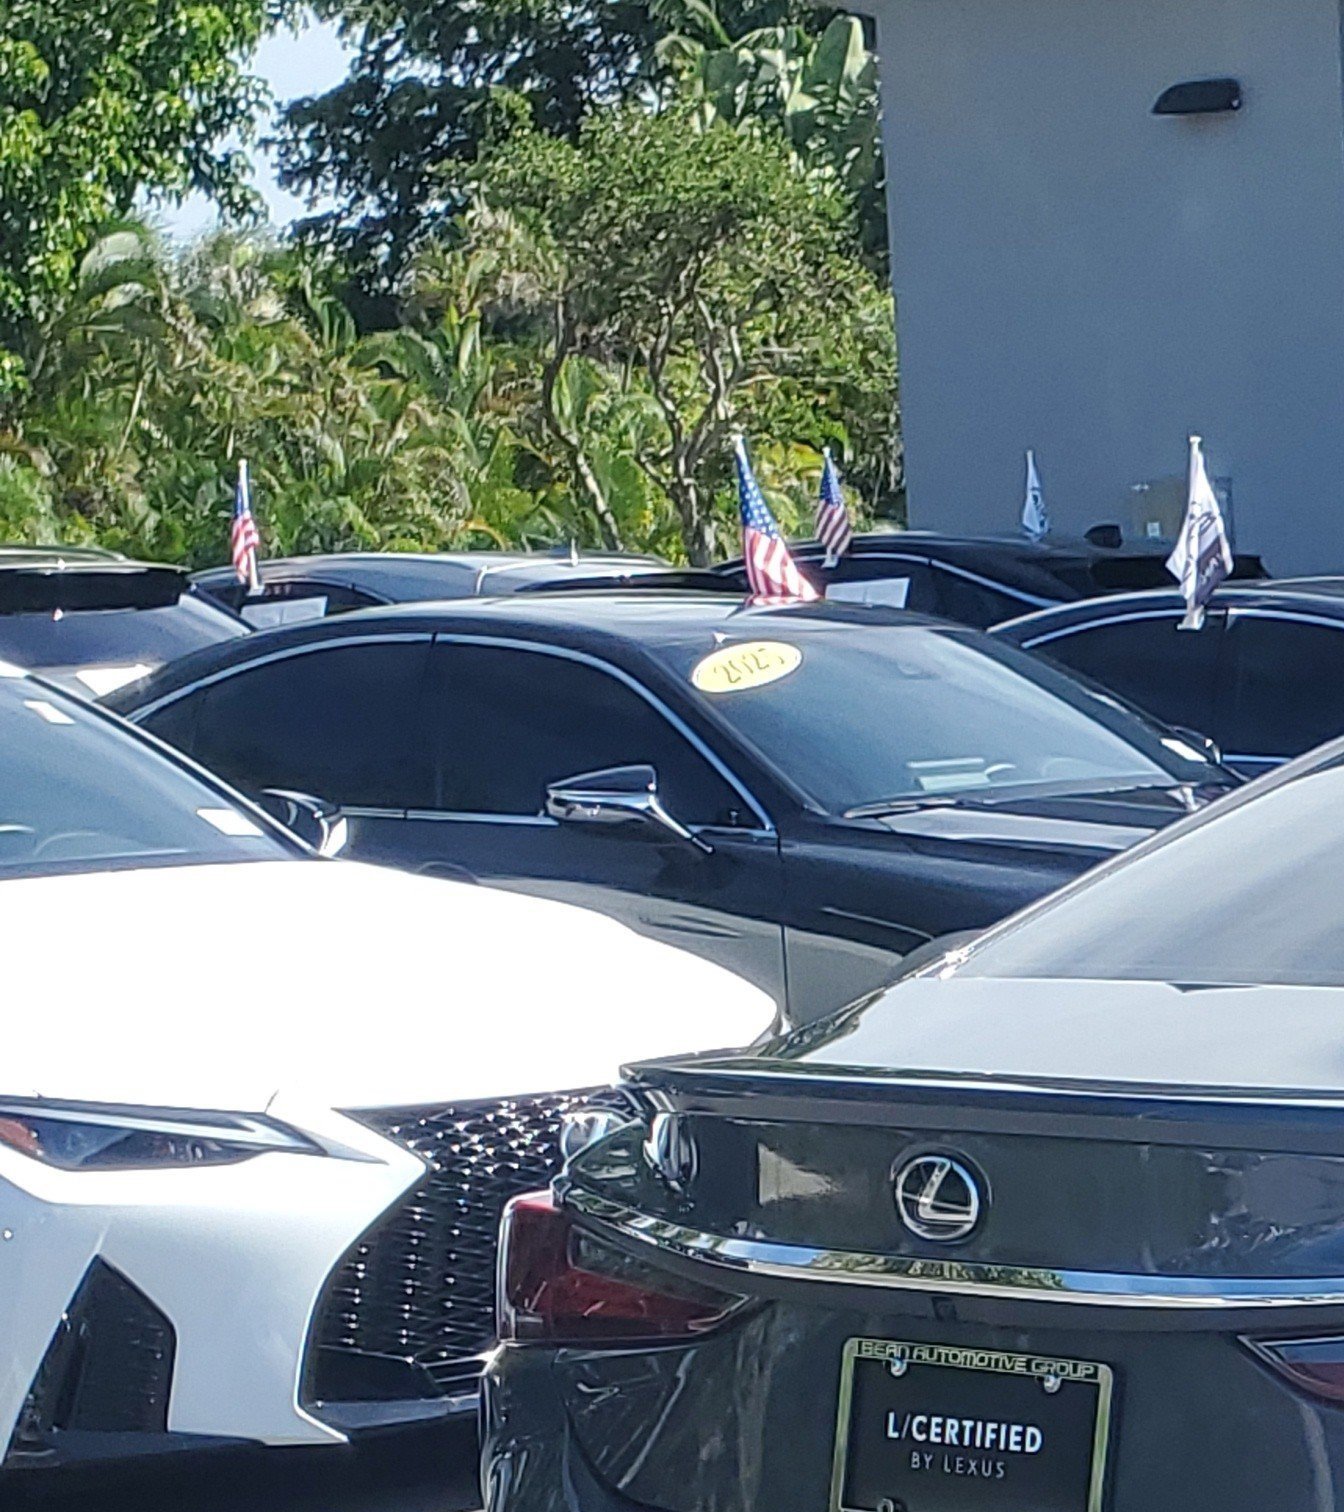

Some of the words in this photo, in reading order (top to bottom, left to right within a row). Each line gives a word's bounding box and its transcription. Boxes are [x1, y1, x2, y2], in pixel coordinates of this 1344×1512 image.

[912, 1346, 1027, 1372] AUTOMOTIVE
[1031, 1359, 1095, 1378] GROUP
[886, 1411, 1043, 1453] L/CERTIFIED
[911, 1451, 933, 1470] BY
[943, 1454, 1006, 1479] LEXUS
